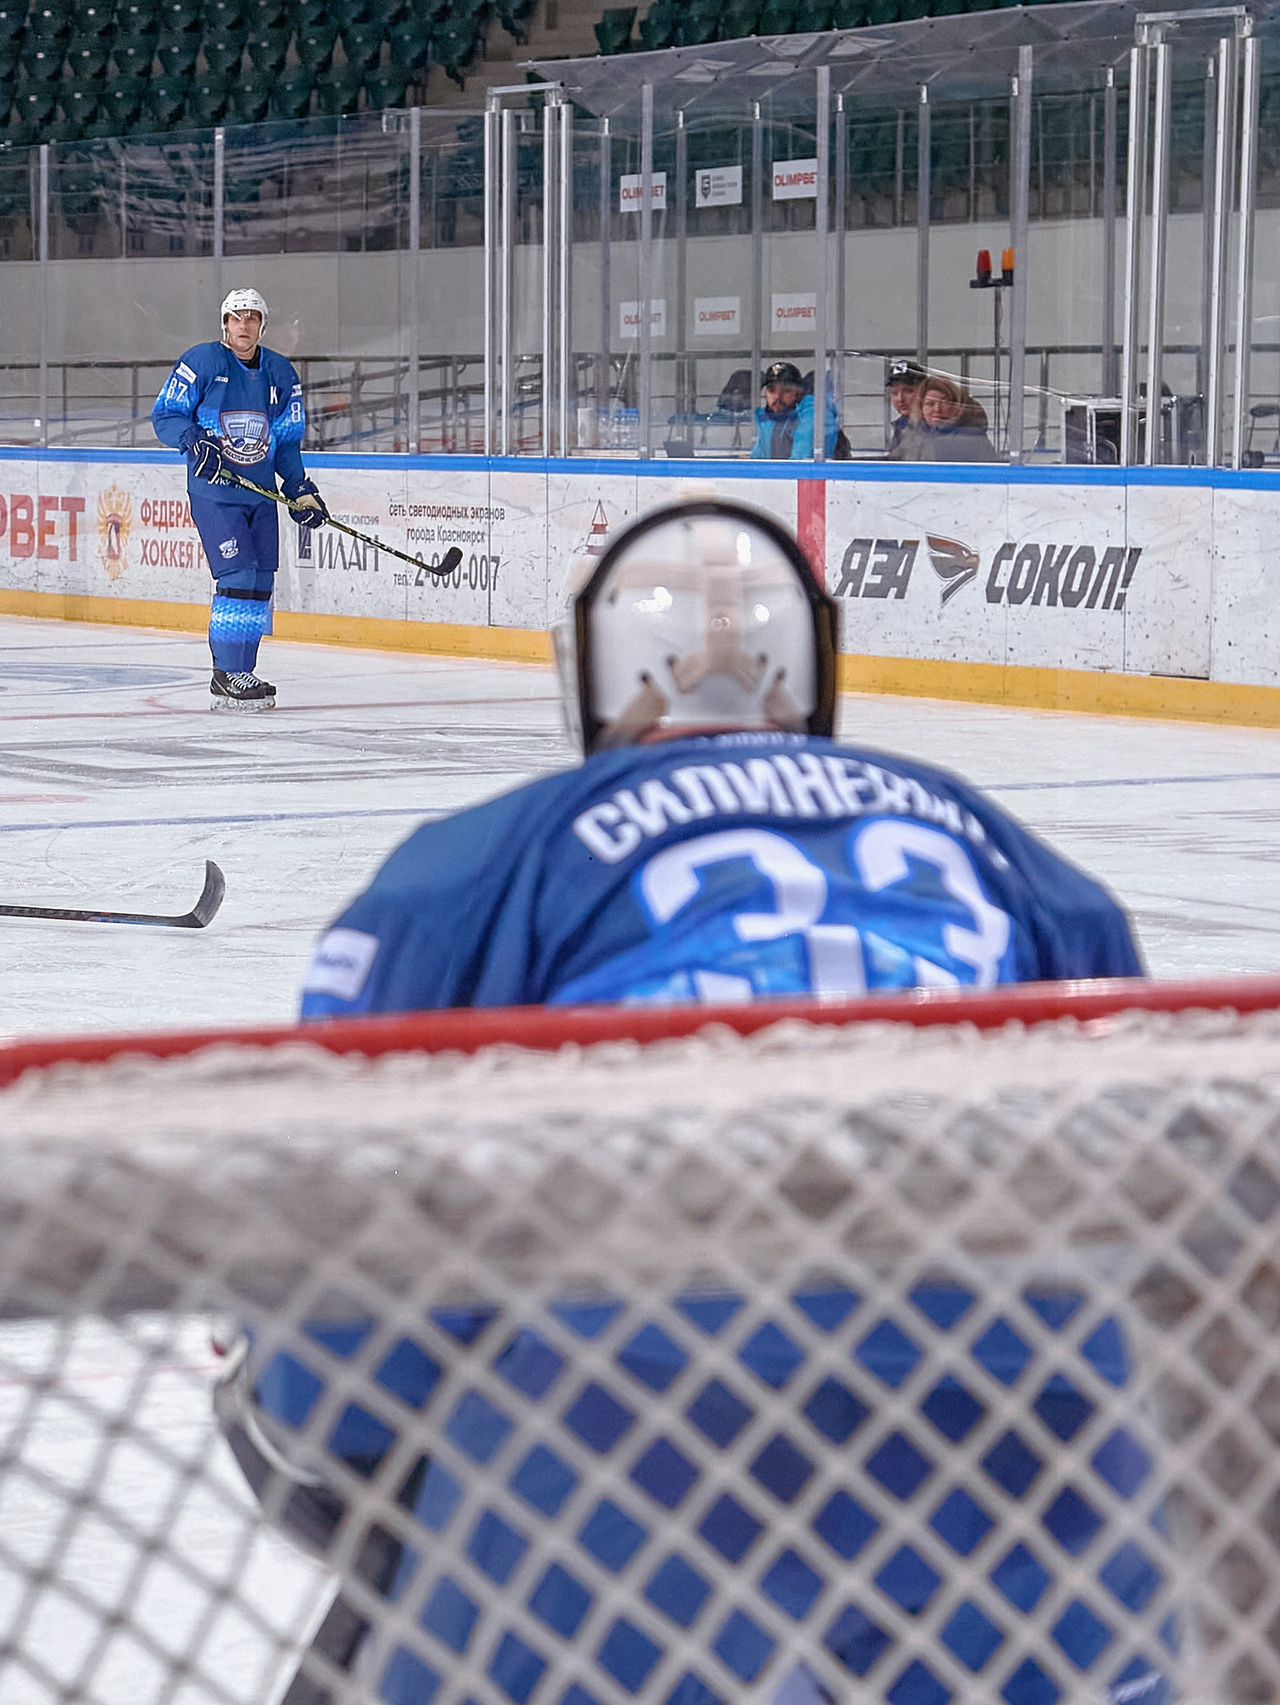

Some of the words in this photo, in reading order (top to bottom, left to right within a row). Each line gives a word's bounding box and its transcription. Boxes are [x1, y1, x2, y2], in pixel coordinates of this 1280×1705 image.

[622, 185, 664, 200] OLIMET
[699, 310, 736, 322] OLIMPBET
[166, 377, 188, 401] 87
[141, 498, 197, 533] ФЕДЕРА
[389, 504, 407, 516] сеть
[409, 504, 469, 519] светодиодных
[470, 506, 506, 521] экранов
[407, 528, 435, 543] города
[140, 539, 194, 568] ХОККЕЯ
[319, 532, 379, 573] ИЛАН
[985, 542, 1143, 611] СОКОЛ!
